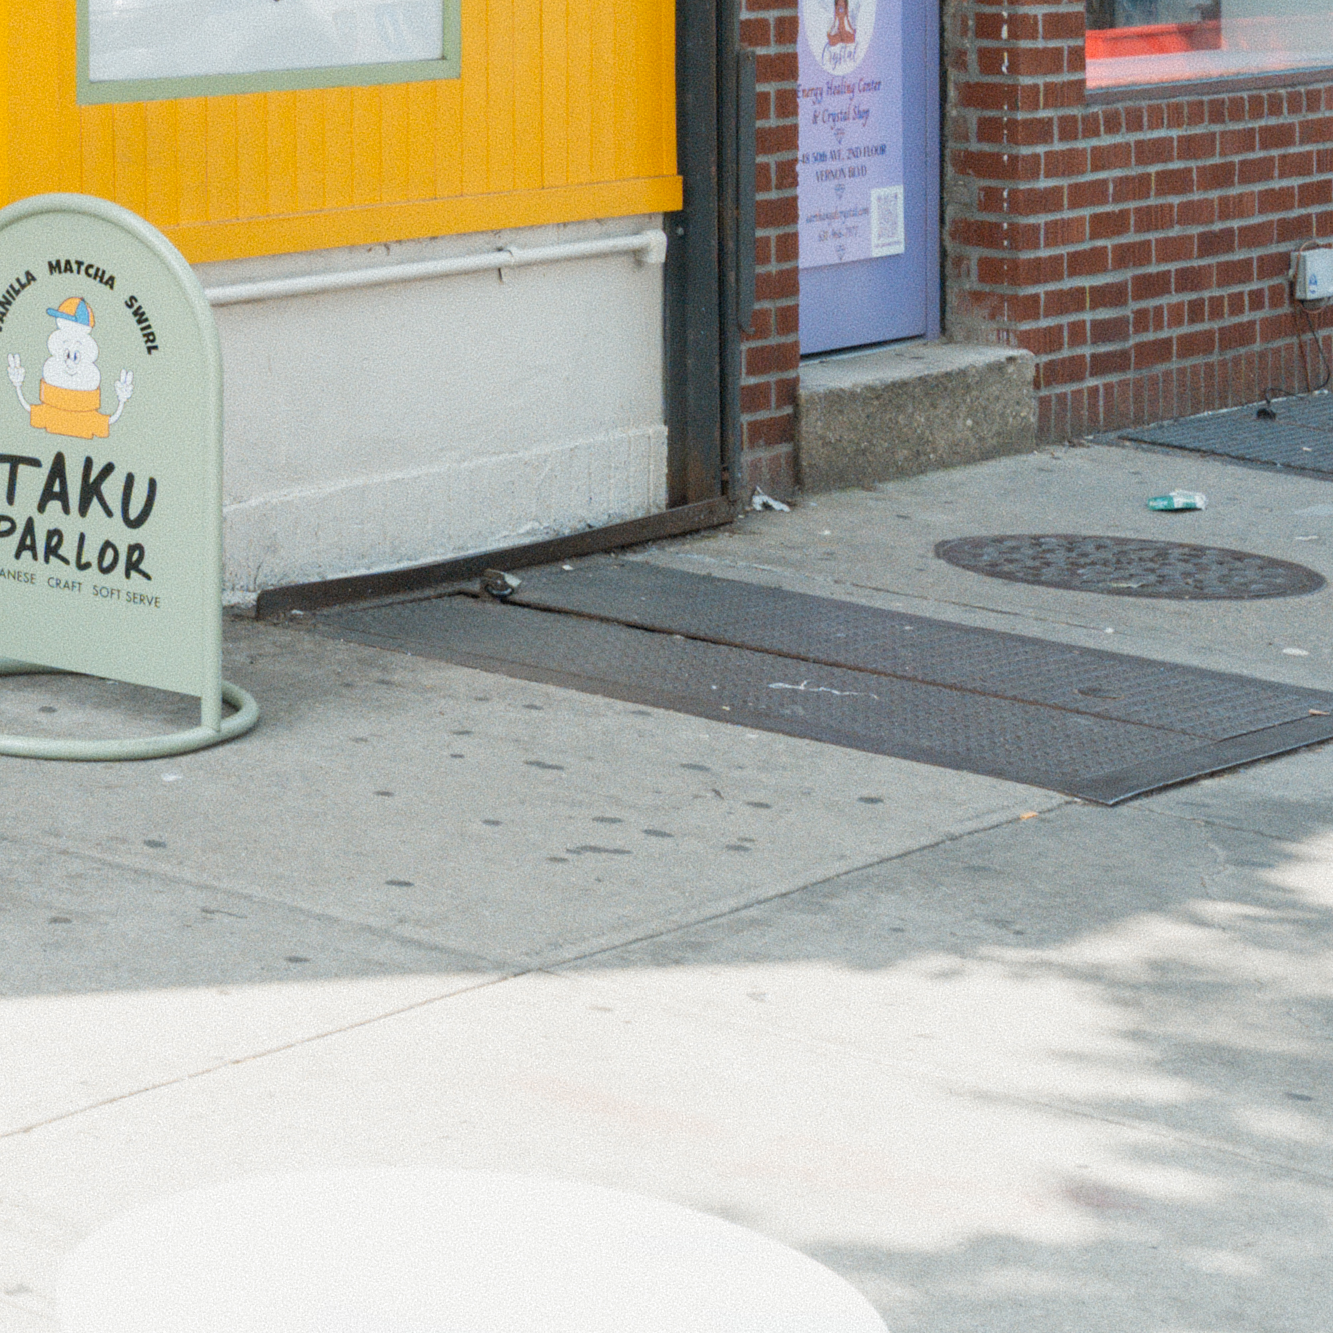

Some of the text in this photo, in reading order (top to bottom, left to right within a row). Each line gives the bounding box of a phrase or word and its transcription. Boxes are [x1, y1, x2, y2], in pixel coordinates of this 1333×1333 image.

[47, 258, 116, 291] MATCHA
[124, 294, 159, 356] SWIRL
[47, 576, 83, 594] CRAFT
[92, 583, 122, 600] SOFT
[125, 590, 161, 609] SERVE
